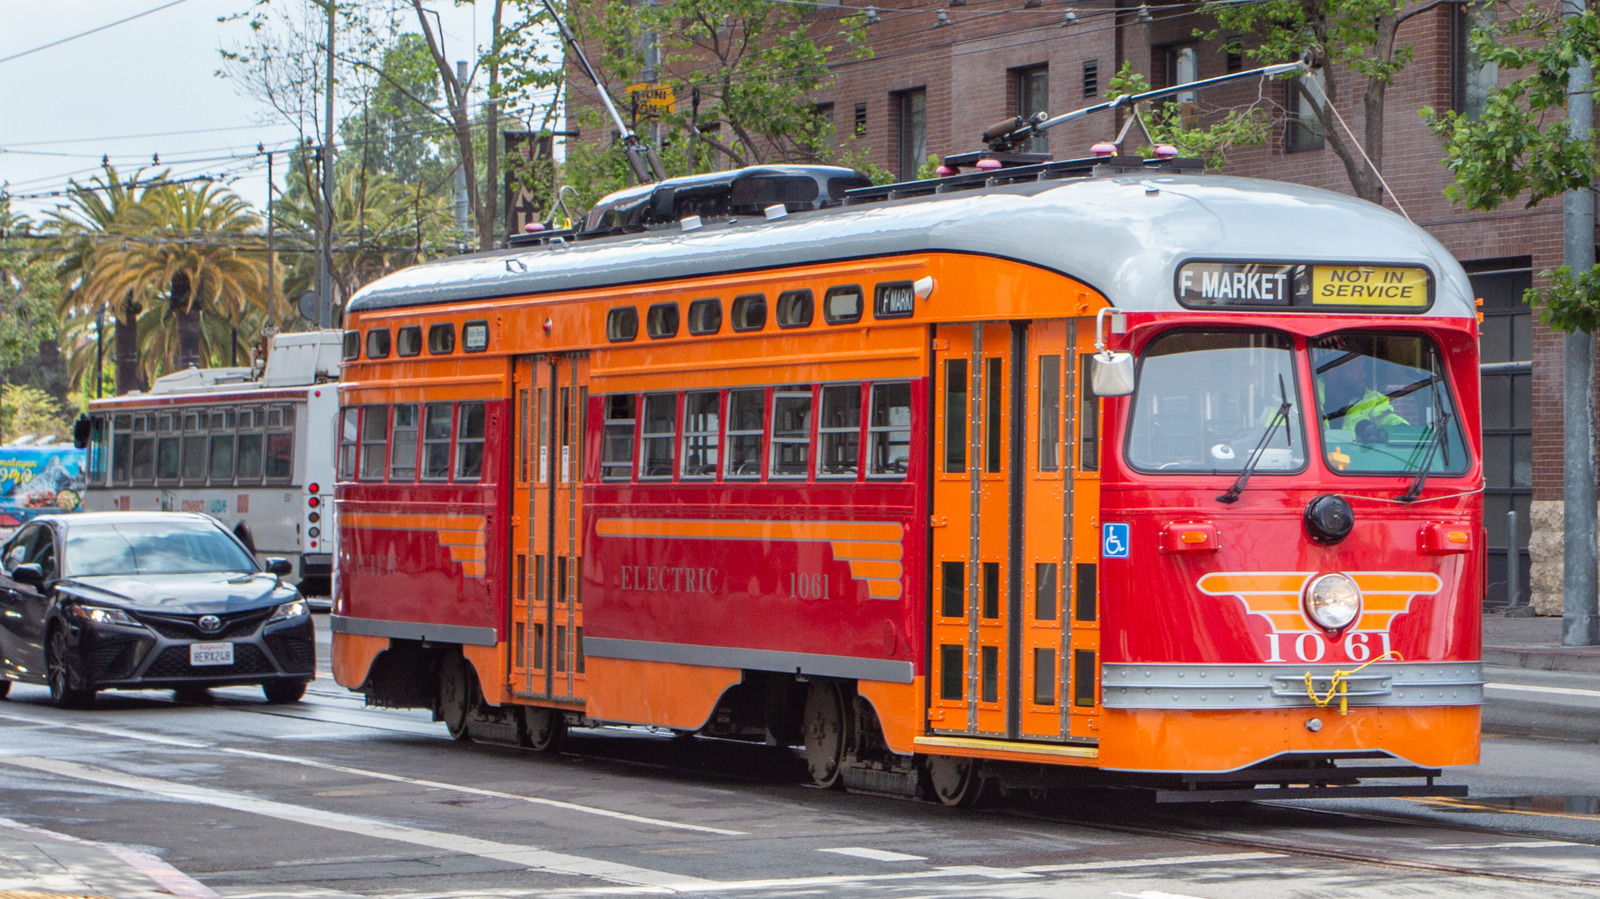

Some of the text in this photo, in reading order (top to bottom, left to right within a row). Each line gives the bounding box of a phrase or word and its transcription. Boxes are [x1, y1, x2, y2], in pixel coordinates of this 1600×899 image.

[1180, 271, 1287, 300] F MARKET
[1330, 270, 1405, 283] NOT IN
[883, 288, 890, 312] F
[1321, 284, 1414, 298] SERVICE
[621, 565, 718, 594] ELECTRIC
[790, 572, 830, 600] 1061
[1264, 632, 1397, 662] 1061
